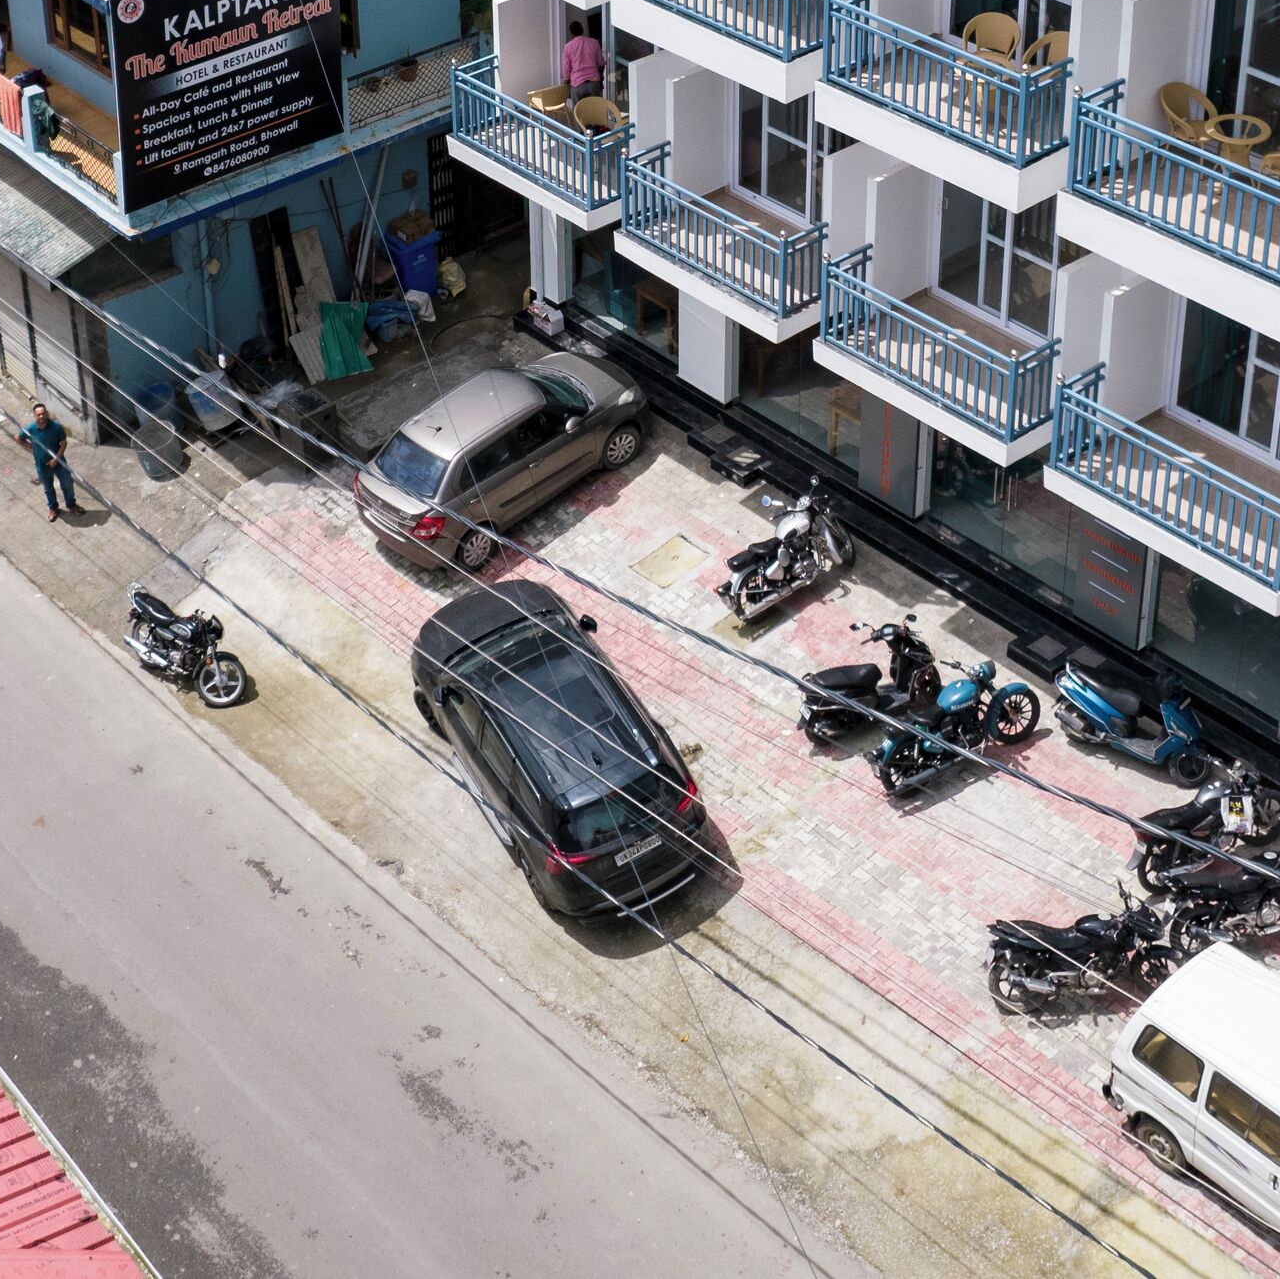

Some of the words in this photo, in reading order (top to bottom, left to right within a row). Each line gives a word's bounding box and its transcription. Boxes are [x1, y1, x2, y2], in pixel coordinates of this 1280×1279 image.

[125, 52, 166, 80] The
[170, 22, 258, 66] Kumaun
[175, 67, 209, 87] HOTEL
[212, 63, 219, 74] &
[223, 39, 289, 70] RESTAURANT
[142, 98, 181, 119] All-Day
[184, 87, 209, 104] Café
[212, 80, 233, 94] and
[235, 58, 289, 85] Restaurant
[142, 111, 191, 135] Spacious
[194, 97, 228, 115] Rooms
[231, 87, 251, 102] with
[254, 79, 273, 96] Hills
[275, 71, 300, 88] View
[143, 124, 194, 150] Breakfast,
[198, 113, 228, 130] Lunch
[231, 107, 238, 118] &
[241, 95, 274, 115] Dinner
[145, 151, 159, 165] Lift
[161, 139, 195, 160] facility
[198, 130, 219, 146] and
[221, 121, 245, 138] 24x7
[247, 111, 279, 131] power
[281, 95, 314, 119] supply
[182, 148, 228, 172] Ramgarh
[230, 137, 258, 156] Road,
[213, 144, 270, 174] 8476080900
